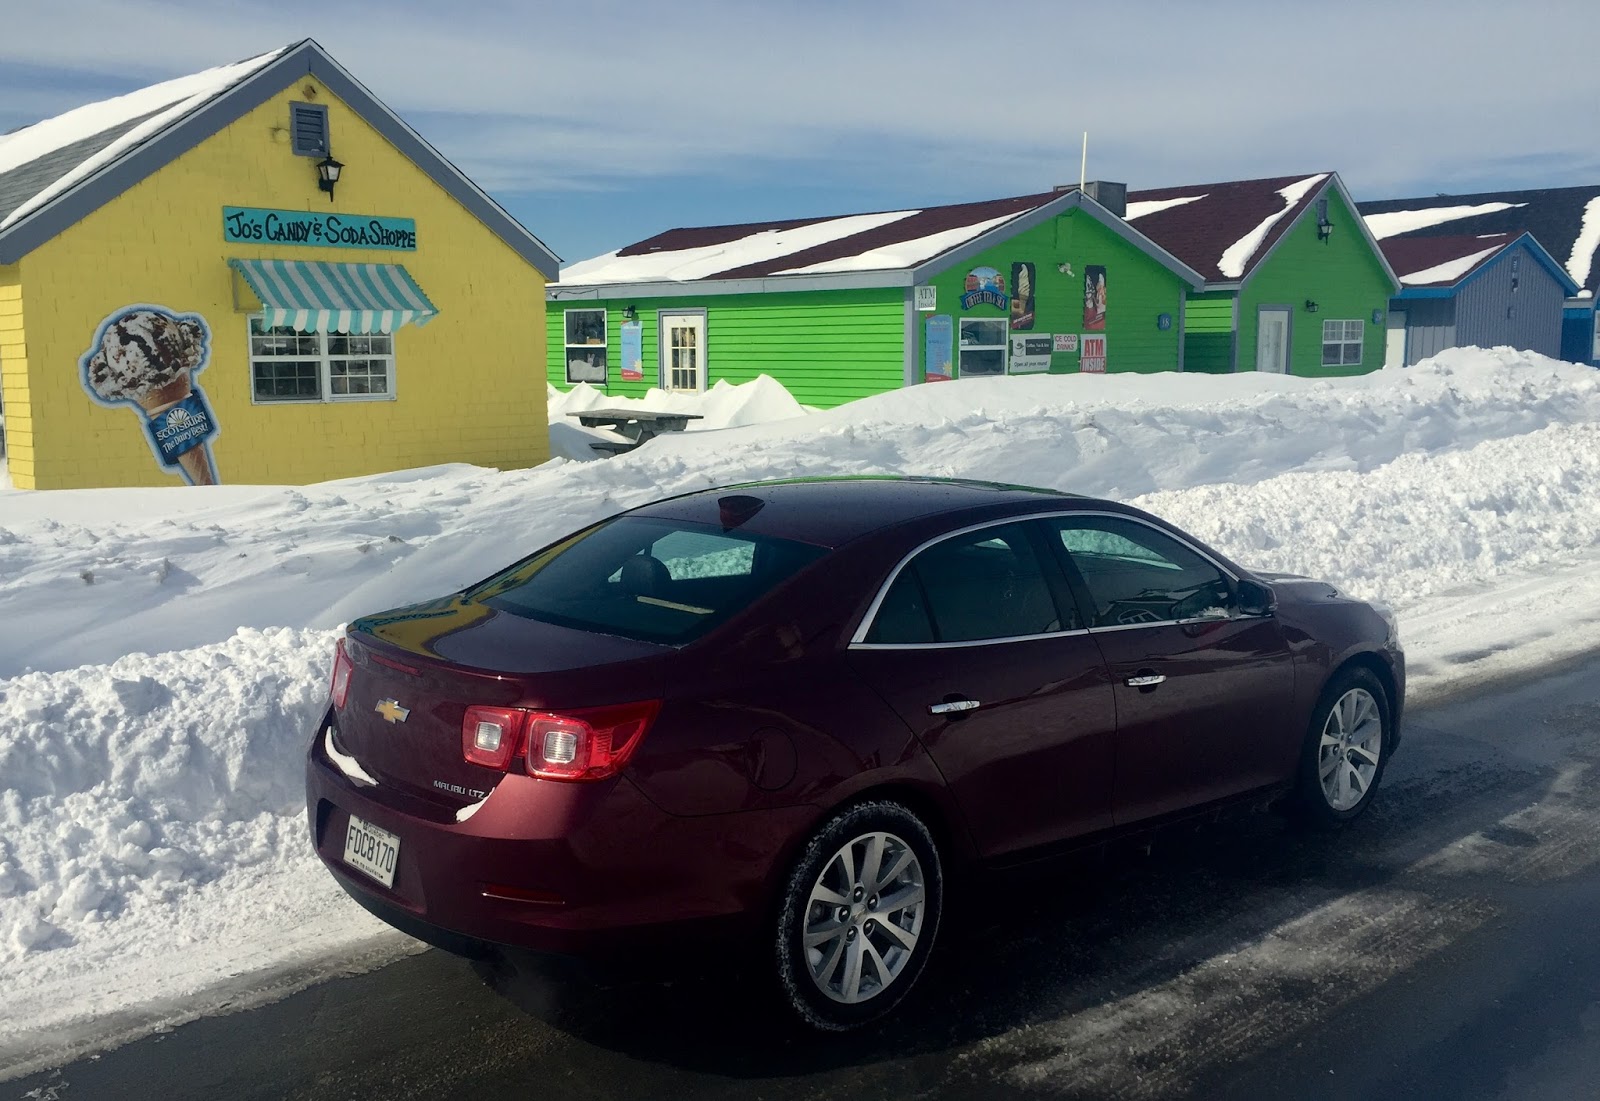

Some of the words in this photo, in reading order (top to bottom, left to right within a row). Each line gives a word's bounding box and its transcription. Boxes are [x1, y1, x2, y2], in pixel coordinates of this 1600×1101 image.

[265, 213, 313, 243] CANDY
[313, 217, 323, 241] &
[324, 216, 370, 245] SODA
[368, 220, 416, 248] SHOPPE
[918, 288, 935, 299] ATM
[918, 300, 935, 308] Inside
[1084, 339, 1104, 356] ATM
[1082, 358, 1105, 371] INSIDE
[156, 411, 206, 441] SCOTSBURN
[163, 441, 175, 453] The
[174, 431, 191, 445] Dairy
[191, 422, 208, 437] Best!
[433, 780, 465, 794] MALIBU
[469, 789, 485, 799] LTZ
[347, 825, 395, 873] FDC8170
